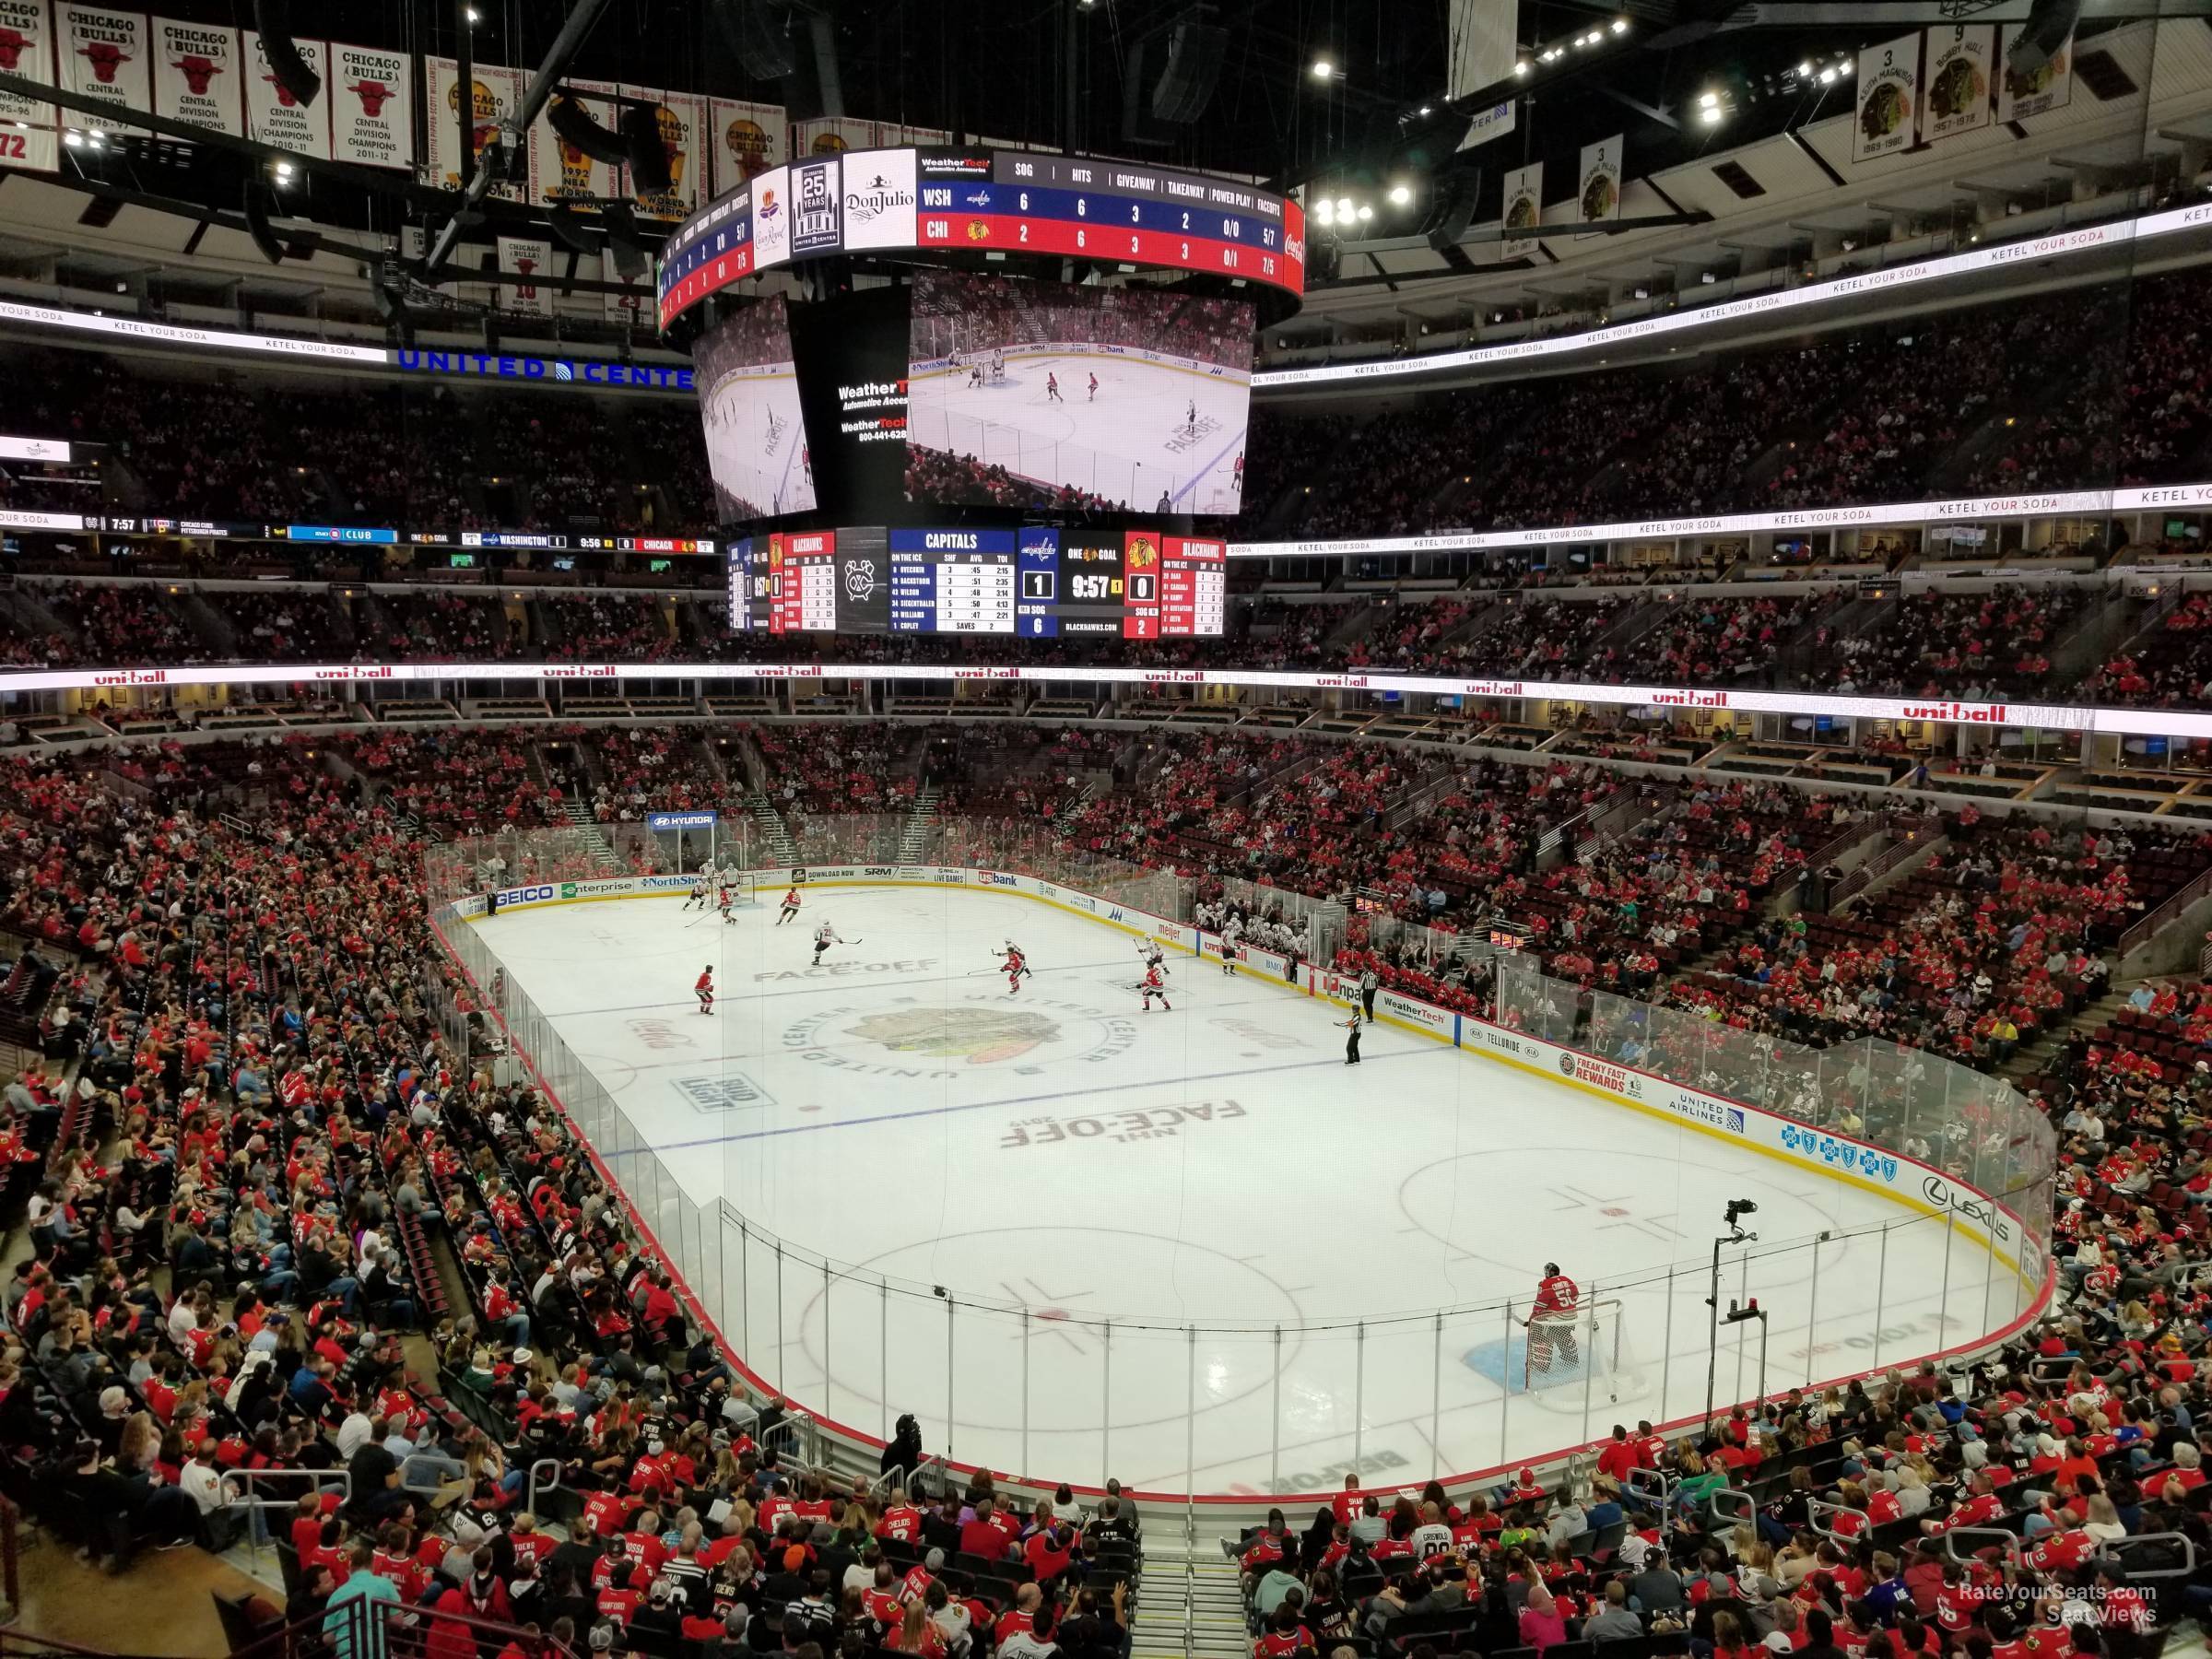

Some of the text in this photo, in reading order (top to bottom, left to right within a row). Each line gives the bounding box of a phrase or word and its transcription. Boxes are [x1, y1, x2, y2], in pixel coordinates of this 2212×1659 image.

[68, 11, 135, 31] CHICAGO
[80, 28, 127, 44] BULLS
[164, 27, 227, 44] CHICAGO
[1955, 25, 1964, 41] 9
[174, 42, 219, 56] BULLS
[1936, 41, 1983, 67] BOBBY HULL
[343, 53, 400, 69] CHICAGO
[1884, 51, 1892, 66] 3
[352, 66, 393, 81] BULLS
[1879, 69, 1915, 88] MAGNUSON
[86, 83, 125, 96] CENTRAL
[180, 96, 217, 107] CENTRAL
[180, 106, 219, 119] DIVISION
[271, 109, 305, 119] CENTRAL
[270, 119, 307, 129] DIVISION
[356, 118, 389, 129] CENTRAL
[264, 129, 313, 142] CHAMPIONS
[354, 128, 390, 139] DIVISION
[728, 131, 773, 144] CHICAGO
[348, 138, 396, 151] CHAMPIONS
[736, 142, 769, 154] BULLS
[1598, 147, 1605, 161] 3
[922, 159, 988, 167] WeatherTech
[562, 166, 589, 177] 1992
[564, 177, 585, 187] NBA
[804, 175, 825, 198] 25
[1015, 162, 1280, 218] SOG HITS GIVEAWAY TAKEAWAY POWER PLAY FACEOFFS
[647, 195, 684, 208] WORLD
[804, 196, 825, 208] YEARS
[924, 189, 1275, 246] WSH 6 6 3 2 0/0 5/7
[926, 220, 948, 238] CHI
[1019, 225, 1027, 242] 2
[1077, 229, 1085, 248] 6
[1132, 236, 1138, 254] 3
[1182, 242, 1188, 260] 3
[1991, 231, 2104, 261] KETEL YOUR SODA
[509, 243, 541, 253] CHICAGO
[114, 322, 207, 341] KETEL YOUR SODA
[265, 339, 356, 356] KETEL YOUR SODA
[398, 348, 545, 379] UNITED
[1939, 497, 2058, 514] KETEL YOUR SODA
[112, 518, 135, 531] 7:57
[346, 529, 371, 540] CLUB
[500, 535, 547, 547] WASHINGTON
[925, 534, 977, 548] CAPITALS
[581, 538, 601, 547] 9:56
[643, 540, 673, 550] CHICAGO
[794, 537, 823, 552] BLACKHAWKS
[1298, 541, 1371, 553] KETEL YOUR SODA
[1068, 548, 1116, 560] ONE GOAL
[1182, 542, 1219, 558] BLACKHAWKS
[1034, 575, 1042, 594] 1
[1072, 575, 1109, 598] 9:57
[1137, 578, 1147, 597] 0
[1031, 606, 1045, 614] SOG
[1135, 607, 1147, 616] SOG
[1033, 618, 1042, 633] 6
[1138, 619, 1145, 634] 2
[672, 816, 712, 824] HYUNDAI
[865, 867, 892, 877] SRM
[566, 881, 632, 894] enterprise
[1045, 886, 1056, 898] AT&T
[496, 886, 553, 906] GEICO
[1070, 899, 1088, 910] AIRLINES
[1159, 923, 1181, 940] meijer
[1266, 959, 1282, 972] BMO
[1384, 996, 1444, 1024] WeatherTech
[1488, 1033, 1520, 1053] TELLURIDE
[1577, 1057, 1627, 1081] FREAKY FAST
[1576, 1067, 1625, 1093] REWARDS
[1680, 1094, 1724, 1114] UNITED
[1669, 1100, 1723, 1124] AIRLINES
[1951, 1192, 2008, 1242] LEXUS
[590, 1500, 608, 1514] KEITH
[888, 1518, 910, 1529] CHELIOS
[1423, 1533, 1448, 1541] GRISWOLD
[514, 1541, 535, 1552] TOEWS
[714, 1583, 735, 1596] TOEWS
[909, 1573, 924, 1593] TOEWS
[1323, 1611, 1342, 1628] SHARP
